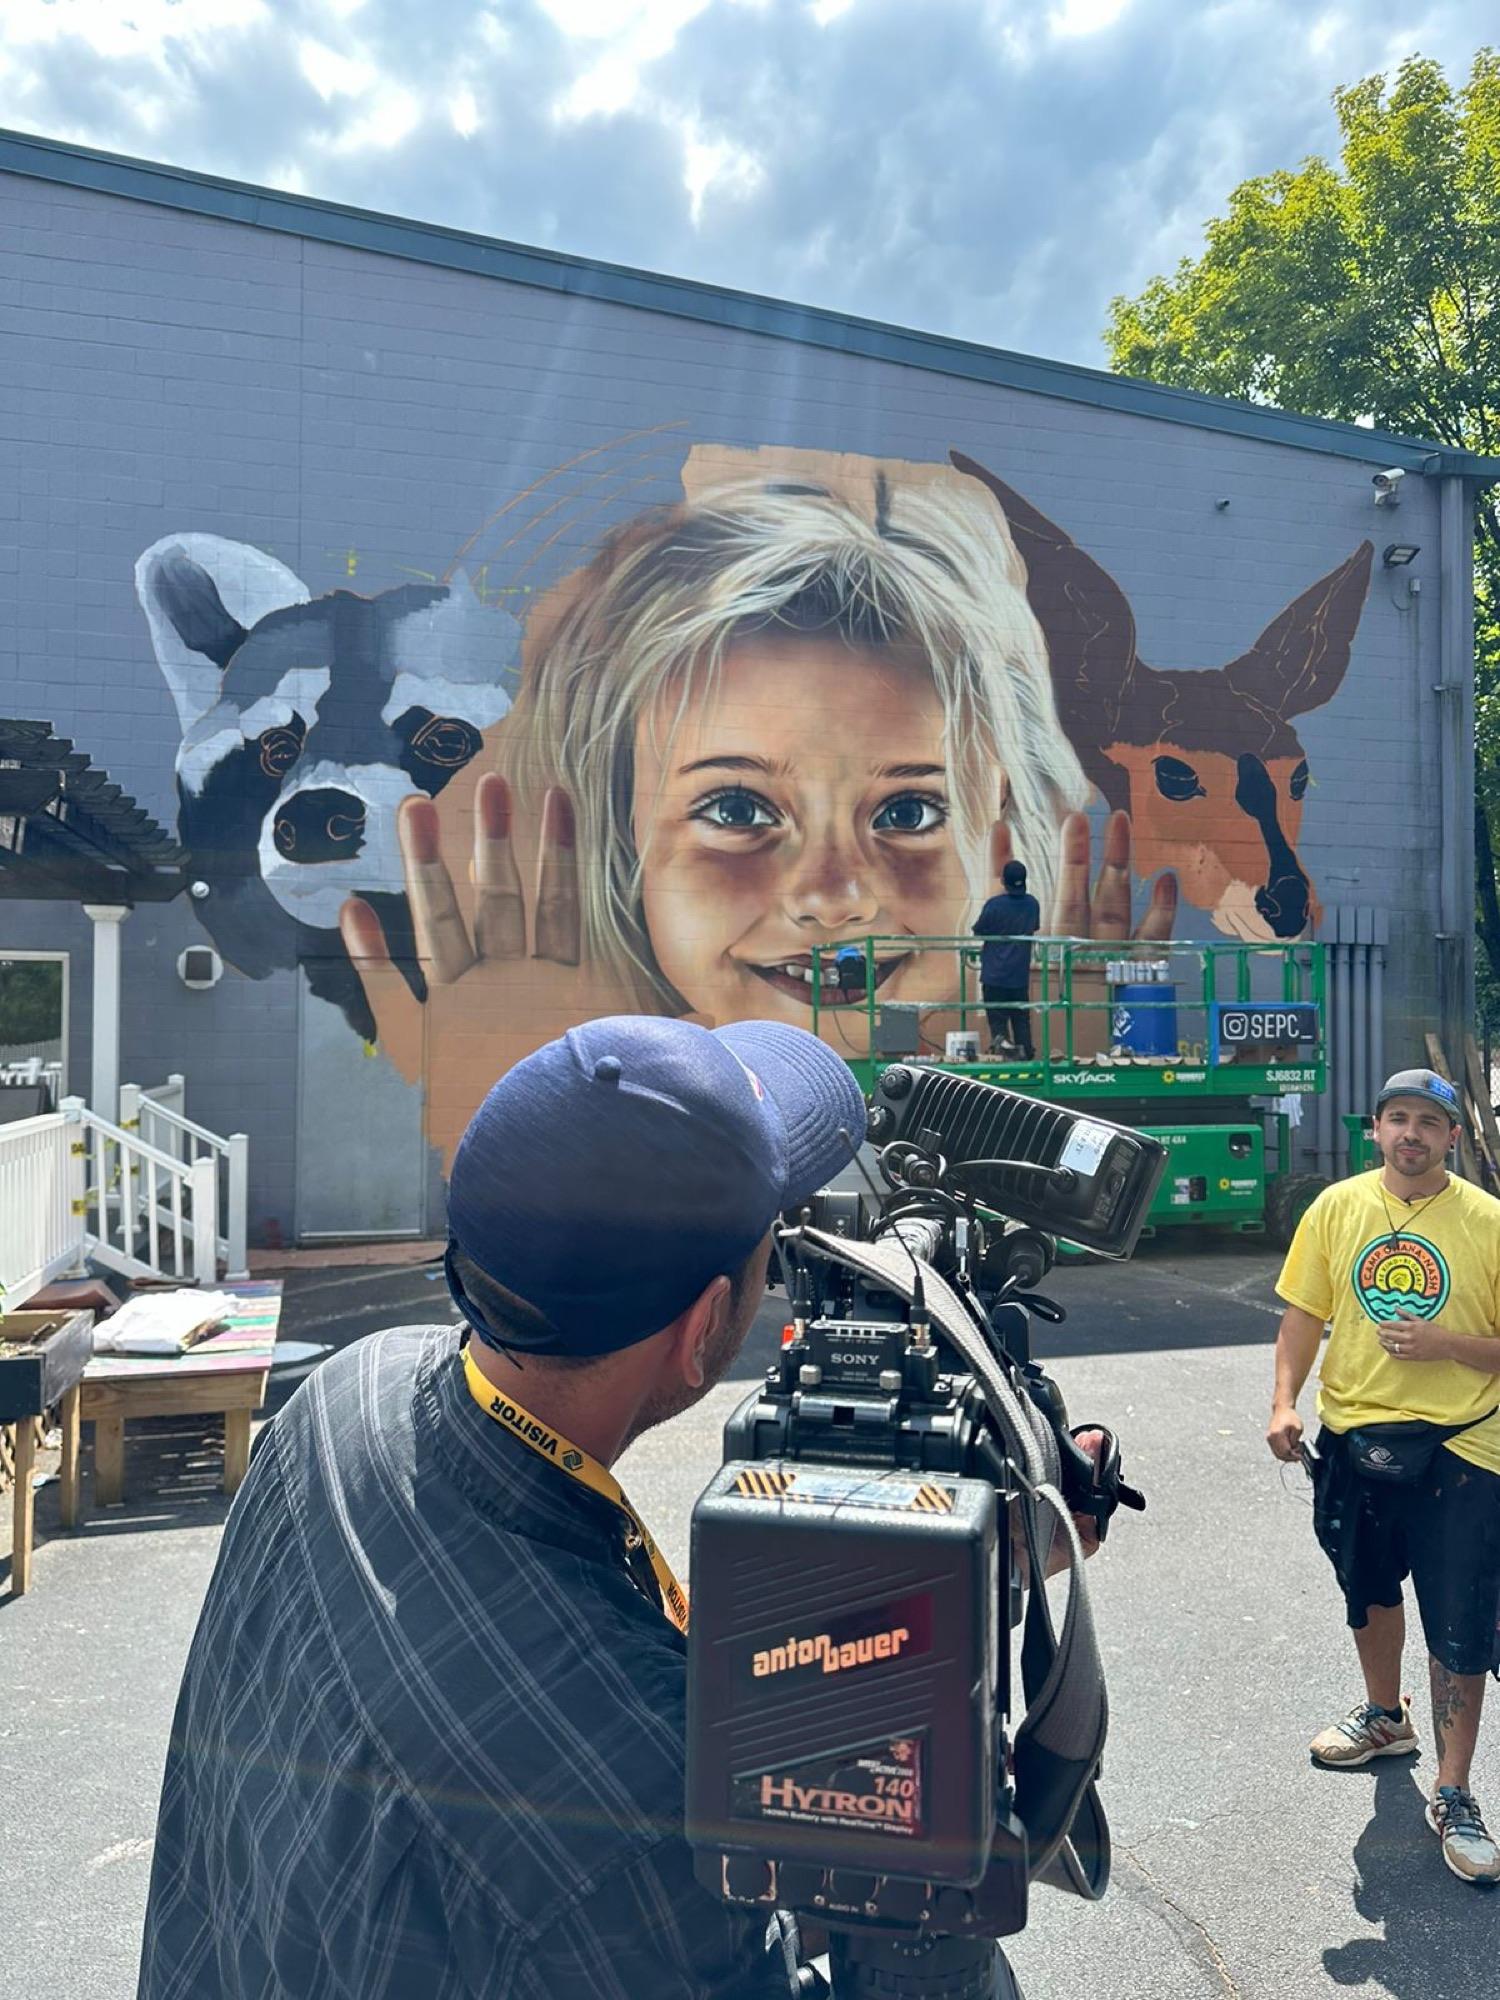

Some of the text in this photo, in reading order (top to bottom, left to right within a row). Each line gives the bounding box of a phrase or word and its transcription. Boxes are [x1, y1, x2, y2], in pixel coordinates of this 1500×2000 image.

[1303, 1069, 1316, 1081] RT
[1364, 1250, 1381, 1281] CAMP
[830, 1353, 880, 1365] SONY
[490, 1395, 558, 1456] VISITOR
[874, 1776, 915, 1798] 140
